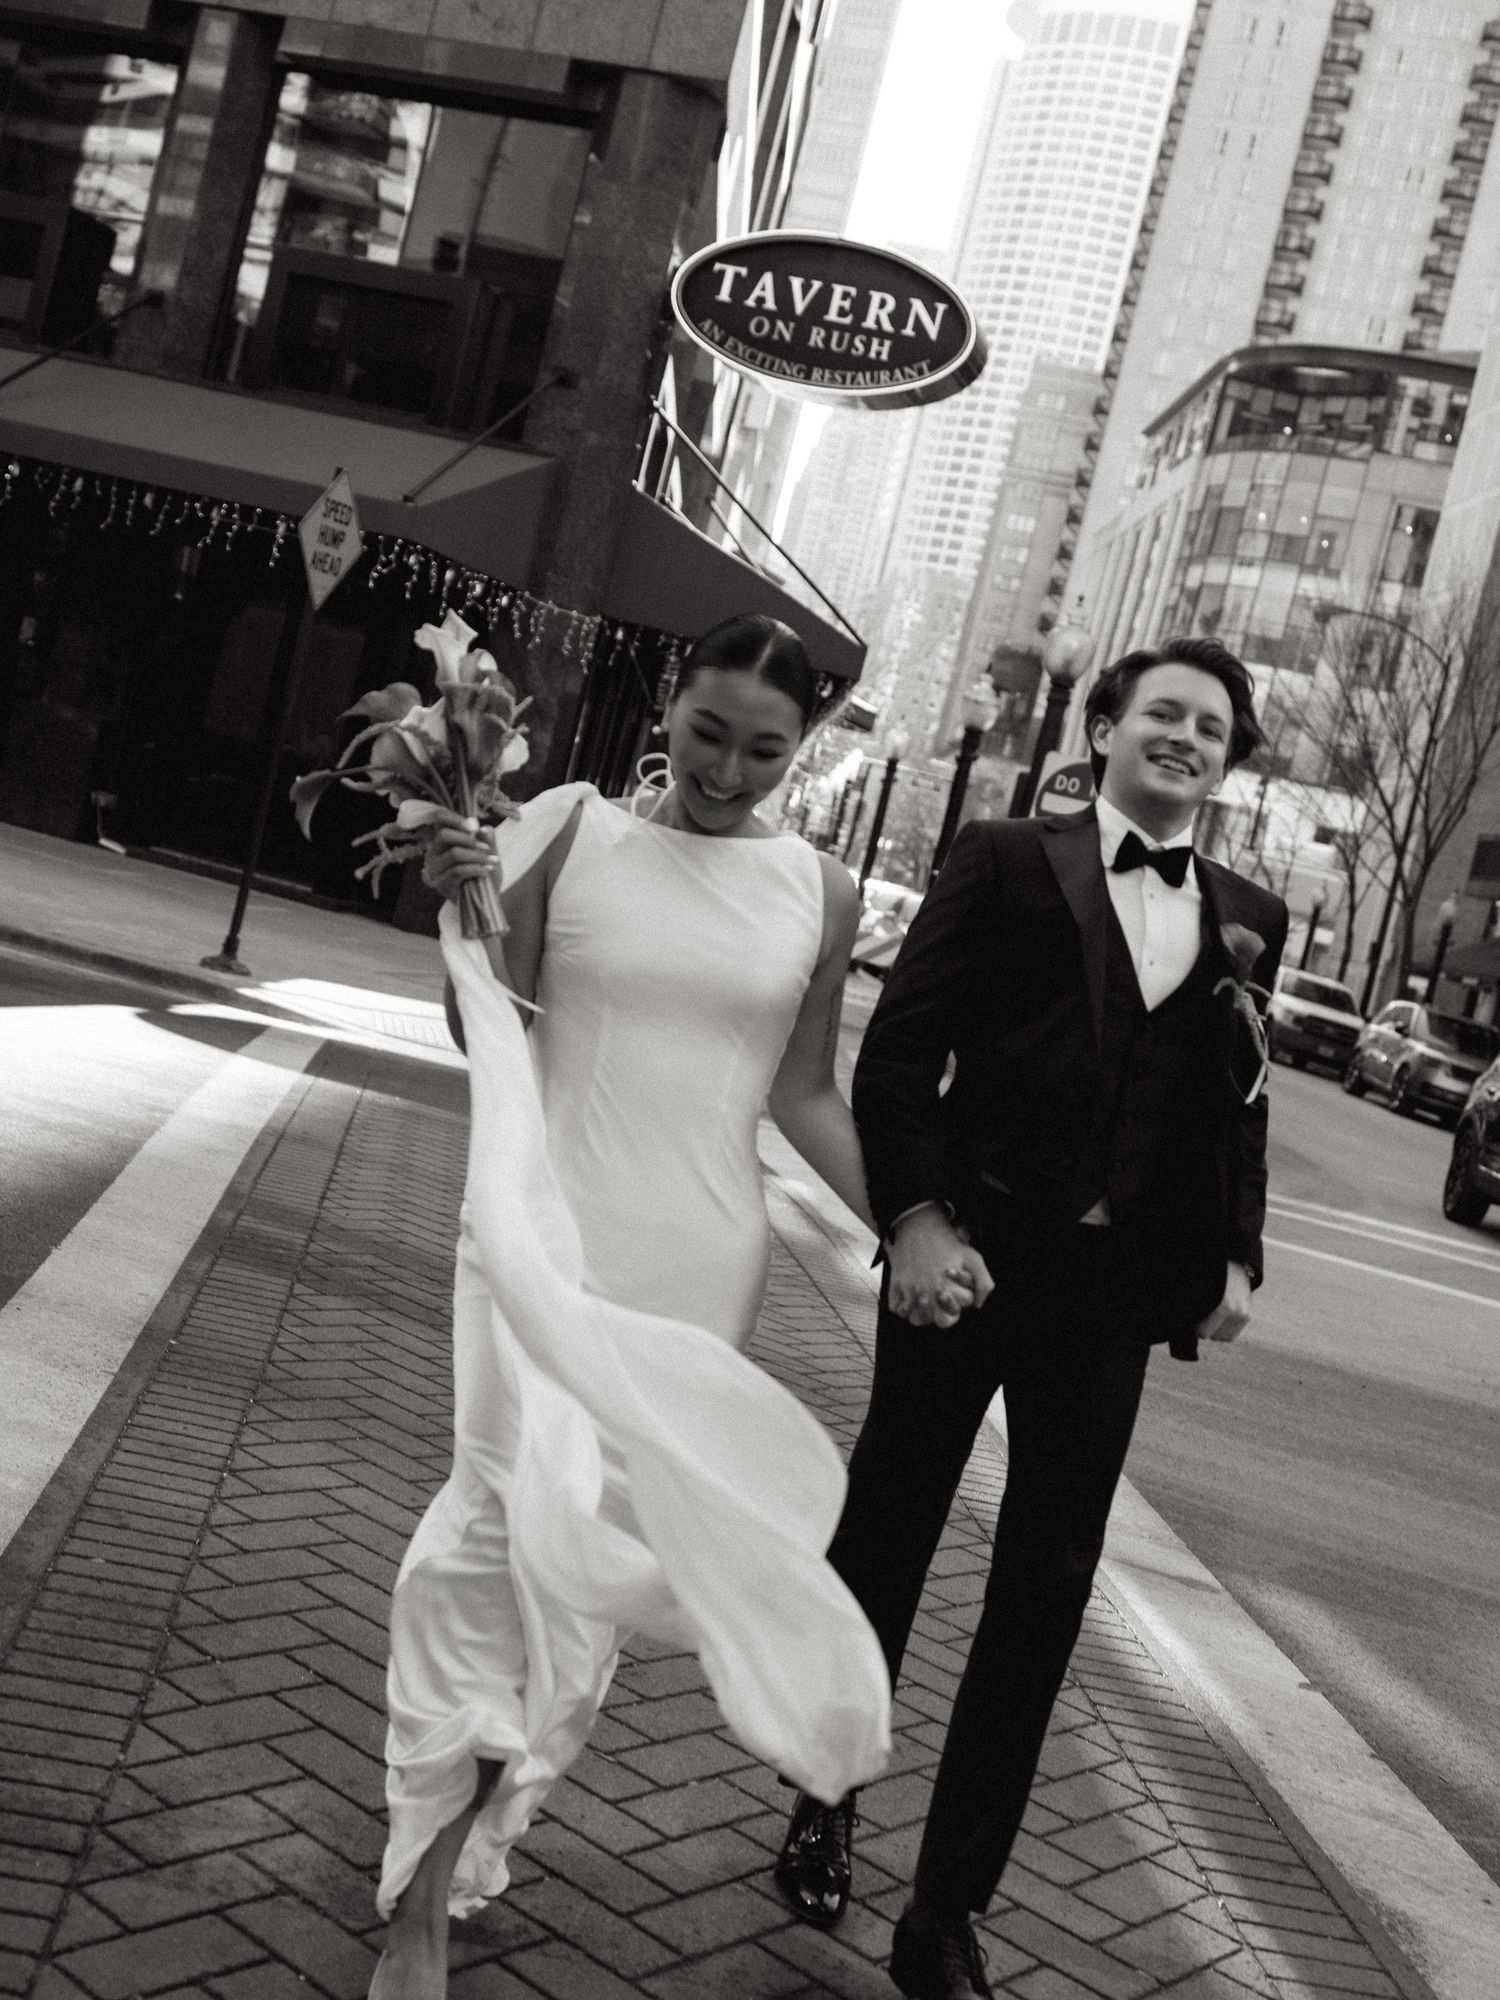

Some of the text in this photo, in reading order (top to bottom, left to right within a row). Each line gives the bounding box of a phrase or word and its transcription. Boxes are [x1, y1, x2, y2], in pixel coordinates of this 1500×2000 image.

[713, 262, 948, 341] TAVERN
[749, 315, 893, 362] ON RUSH
[700, 318, 932, 387] AN EXCITING RESTAURANT
[322, 498, 352, 525] SPEED
[318, 525, 345, 549] HUMP
[311, 550, 342, 576] AHEAD
[1054, 773, 1081, 794] DO
